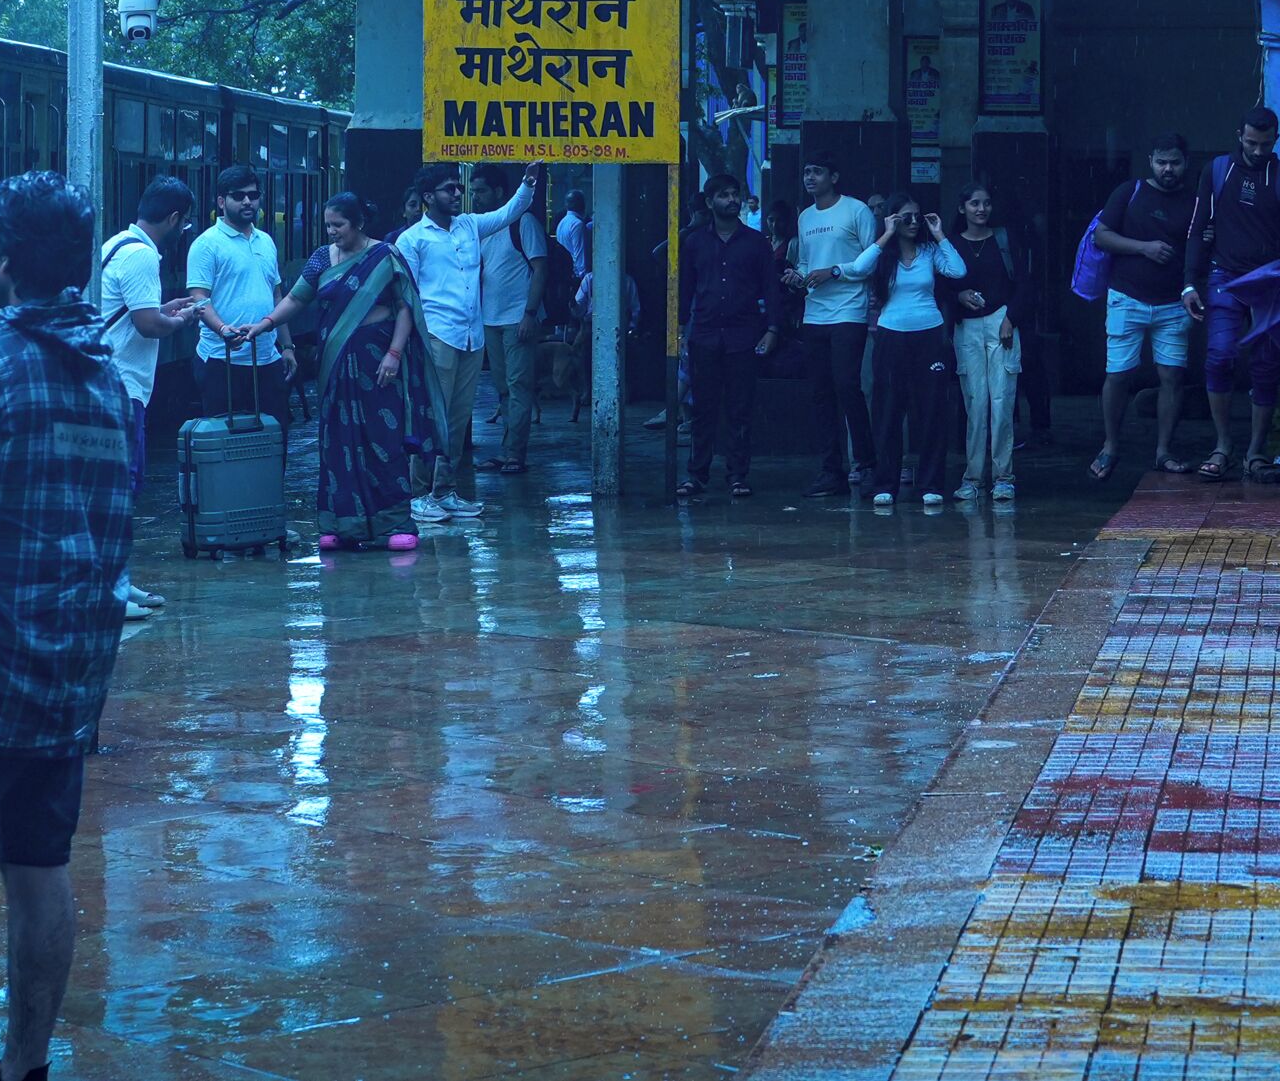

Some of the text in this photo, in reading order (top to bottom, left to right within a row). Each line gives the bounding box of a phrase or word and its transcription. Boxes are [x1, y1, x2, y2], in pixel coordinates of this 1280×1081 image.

[454, 32, 633, 93] माथेरान
[443, 100, 655, 138] MATHERAN
[441, 144, 479, 156] HEIGHT
[481, 144, 515, 157] ABOVE
[524, 143, 560, 157] M.S.L.
